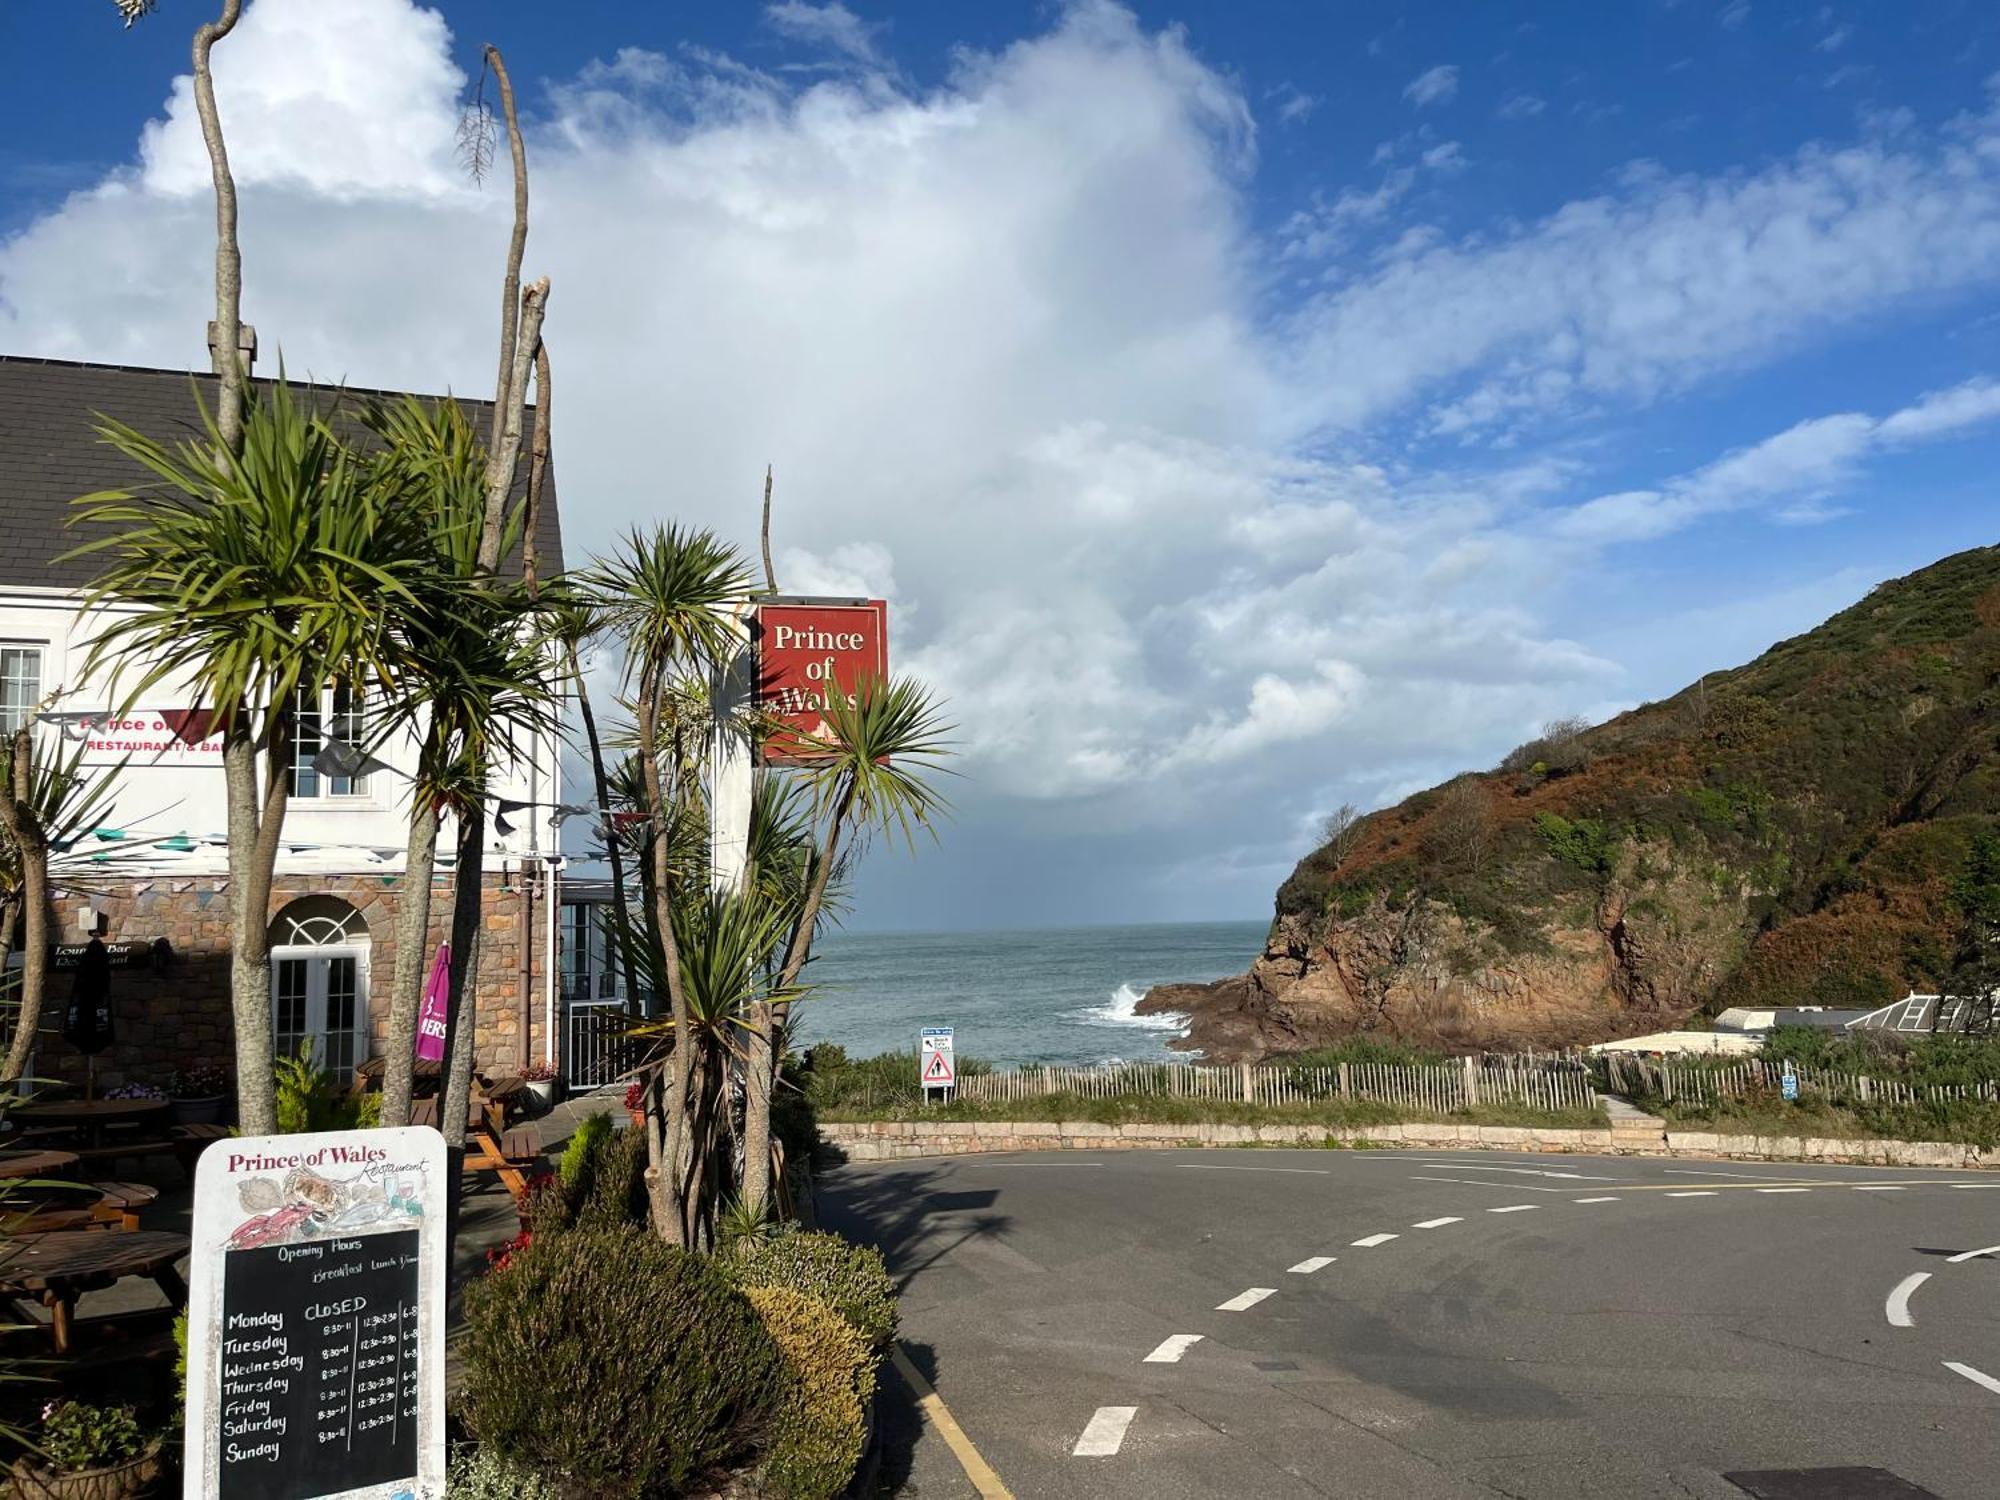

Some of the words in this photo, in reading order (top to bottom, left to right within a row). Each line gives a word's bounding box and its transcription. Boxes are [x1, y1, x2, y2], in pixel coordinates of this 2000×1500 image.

[774, 626, 864, 650] Prince
[806, 656, 835, 680] of
[780, 687, 857, 712] Wals
[80, 716, 145, 731] Pnce
[107, 944, 132, 953] Bar
[228, 1153, 299, 1172] Prince
[306, 1149, 328, 1166] of
[331, 1145, 387, 1163] Wales
[278, 1246, 324, 1263] Opening
[331, 1238, 363, 1253] Hours
[228, 1311, 284, 1332] Monday
[304, 1296, 367, 1321] CLOSED
[223, 1335, 288, 1356] Tuesday
[224, 1355, 304, 1378] Wednesday
[223, 1377, 289, 1396] Thursday
[225, 1399, 270, 1417] Friday
[223, 1416, 287, 1437] Saturday
[225, 1442, 280, 1463] Sunday
